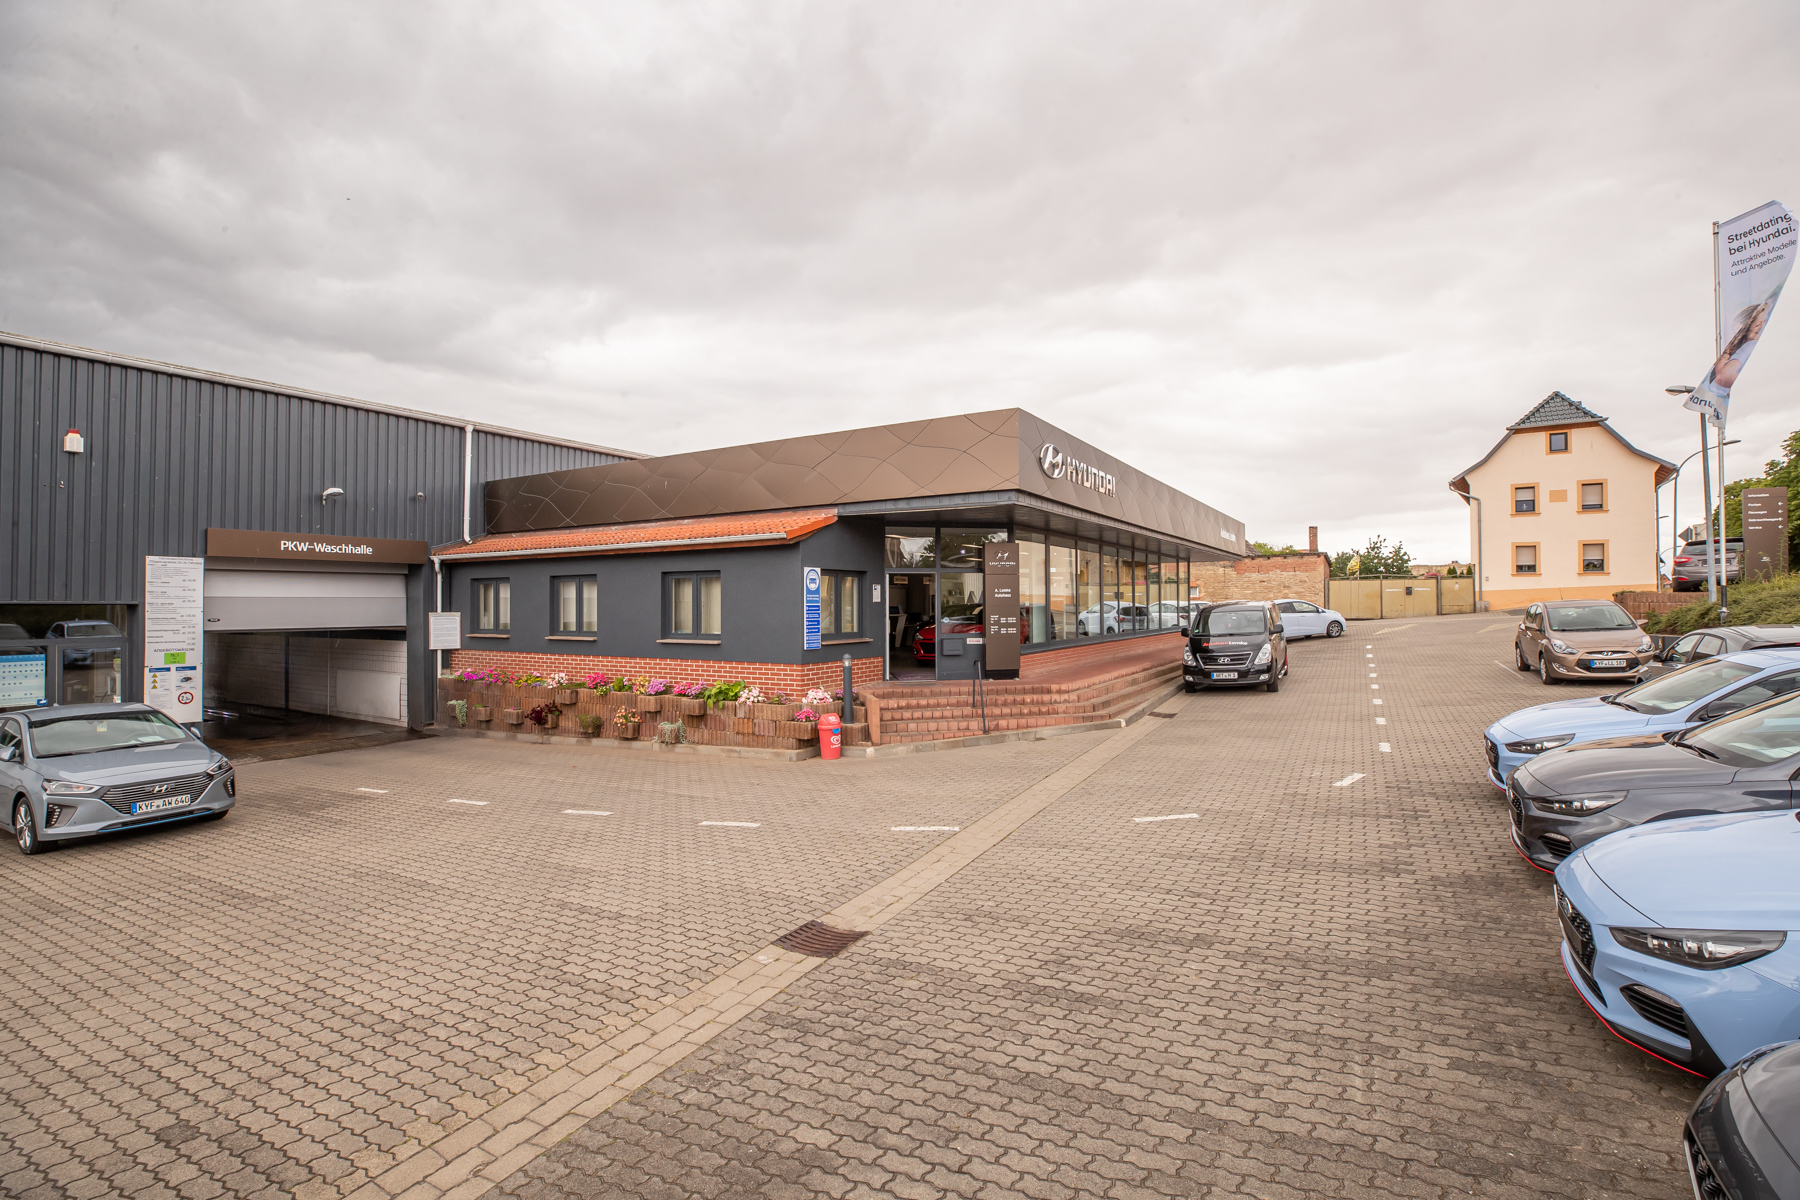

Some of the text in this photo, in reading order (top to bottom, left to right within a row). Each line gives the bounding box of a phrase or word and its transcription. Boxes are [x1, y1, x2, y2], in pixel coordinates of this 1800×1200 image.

[1727, 213, 1792, 244] Streetdating
[1728, 223, 1796, 256] bei Hyundai.
[1730, 253, 1786, 277] und Angebote.
[1731, 239, 1797, 268] Attraktive Modelle
[1067, 455, 1116, 498] HYUNDAI
[280, 540, 373, 555] PKW-Waschhalle
[138, 801, 155, 812] KYF
[174, 795, 190, 806] 640
